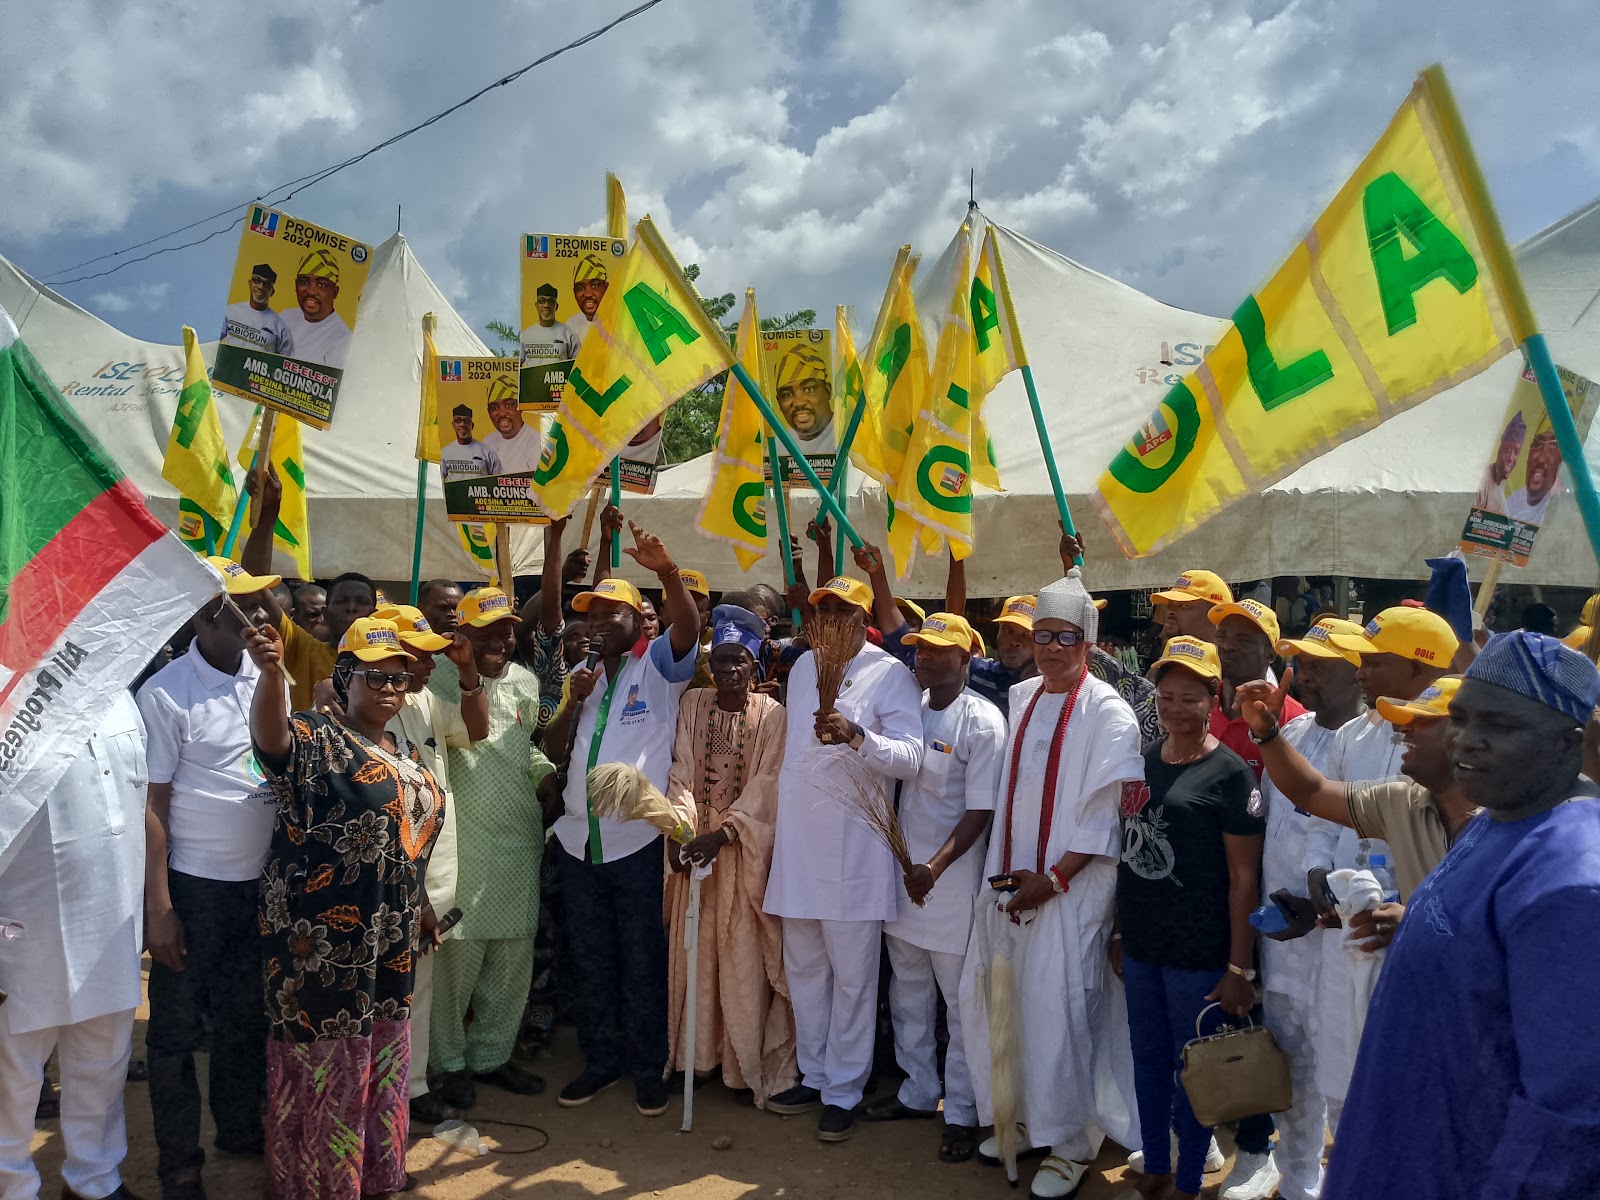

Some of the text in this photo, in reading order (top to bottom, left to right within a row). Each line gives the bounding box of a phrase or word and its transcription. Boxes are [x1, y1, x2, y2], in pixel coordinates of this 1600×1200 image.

[256, 226, 271, 236] APC
[285, 220, 348, 252] PROMISE
[283, 231, 310, 249] 2024
[555, 238, 607, 251] PROMISE
[555, 249, 579, 258] 2024
[229, 325, 267, 344] ABIODUN
[762, 330, 802, 340] ROMISE
[468, 361, 519, 372] PROMISE
[243, 357, 333, 402] AMB. OGUNSOLA
[283, 359, 338, 388] RE-ELECT
[468, 372, 491, 380] 2024
[62, 380, 134, 398] Rental
[248, 373, 283, 392] ADESINA
[1145, 434, 1167, 452] APC
[808, 458, 836, 468] GUNSOLA
[468, 486, 491, 498] AMB.
[475, 498, 503, 506] ADESINA
[1414, 647, 1435, 660] OOLG
